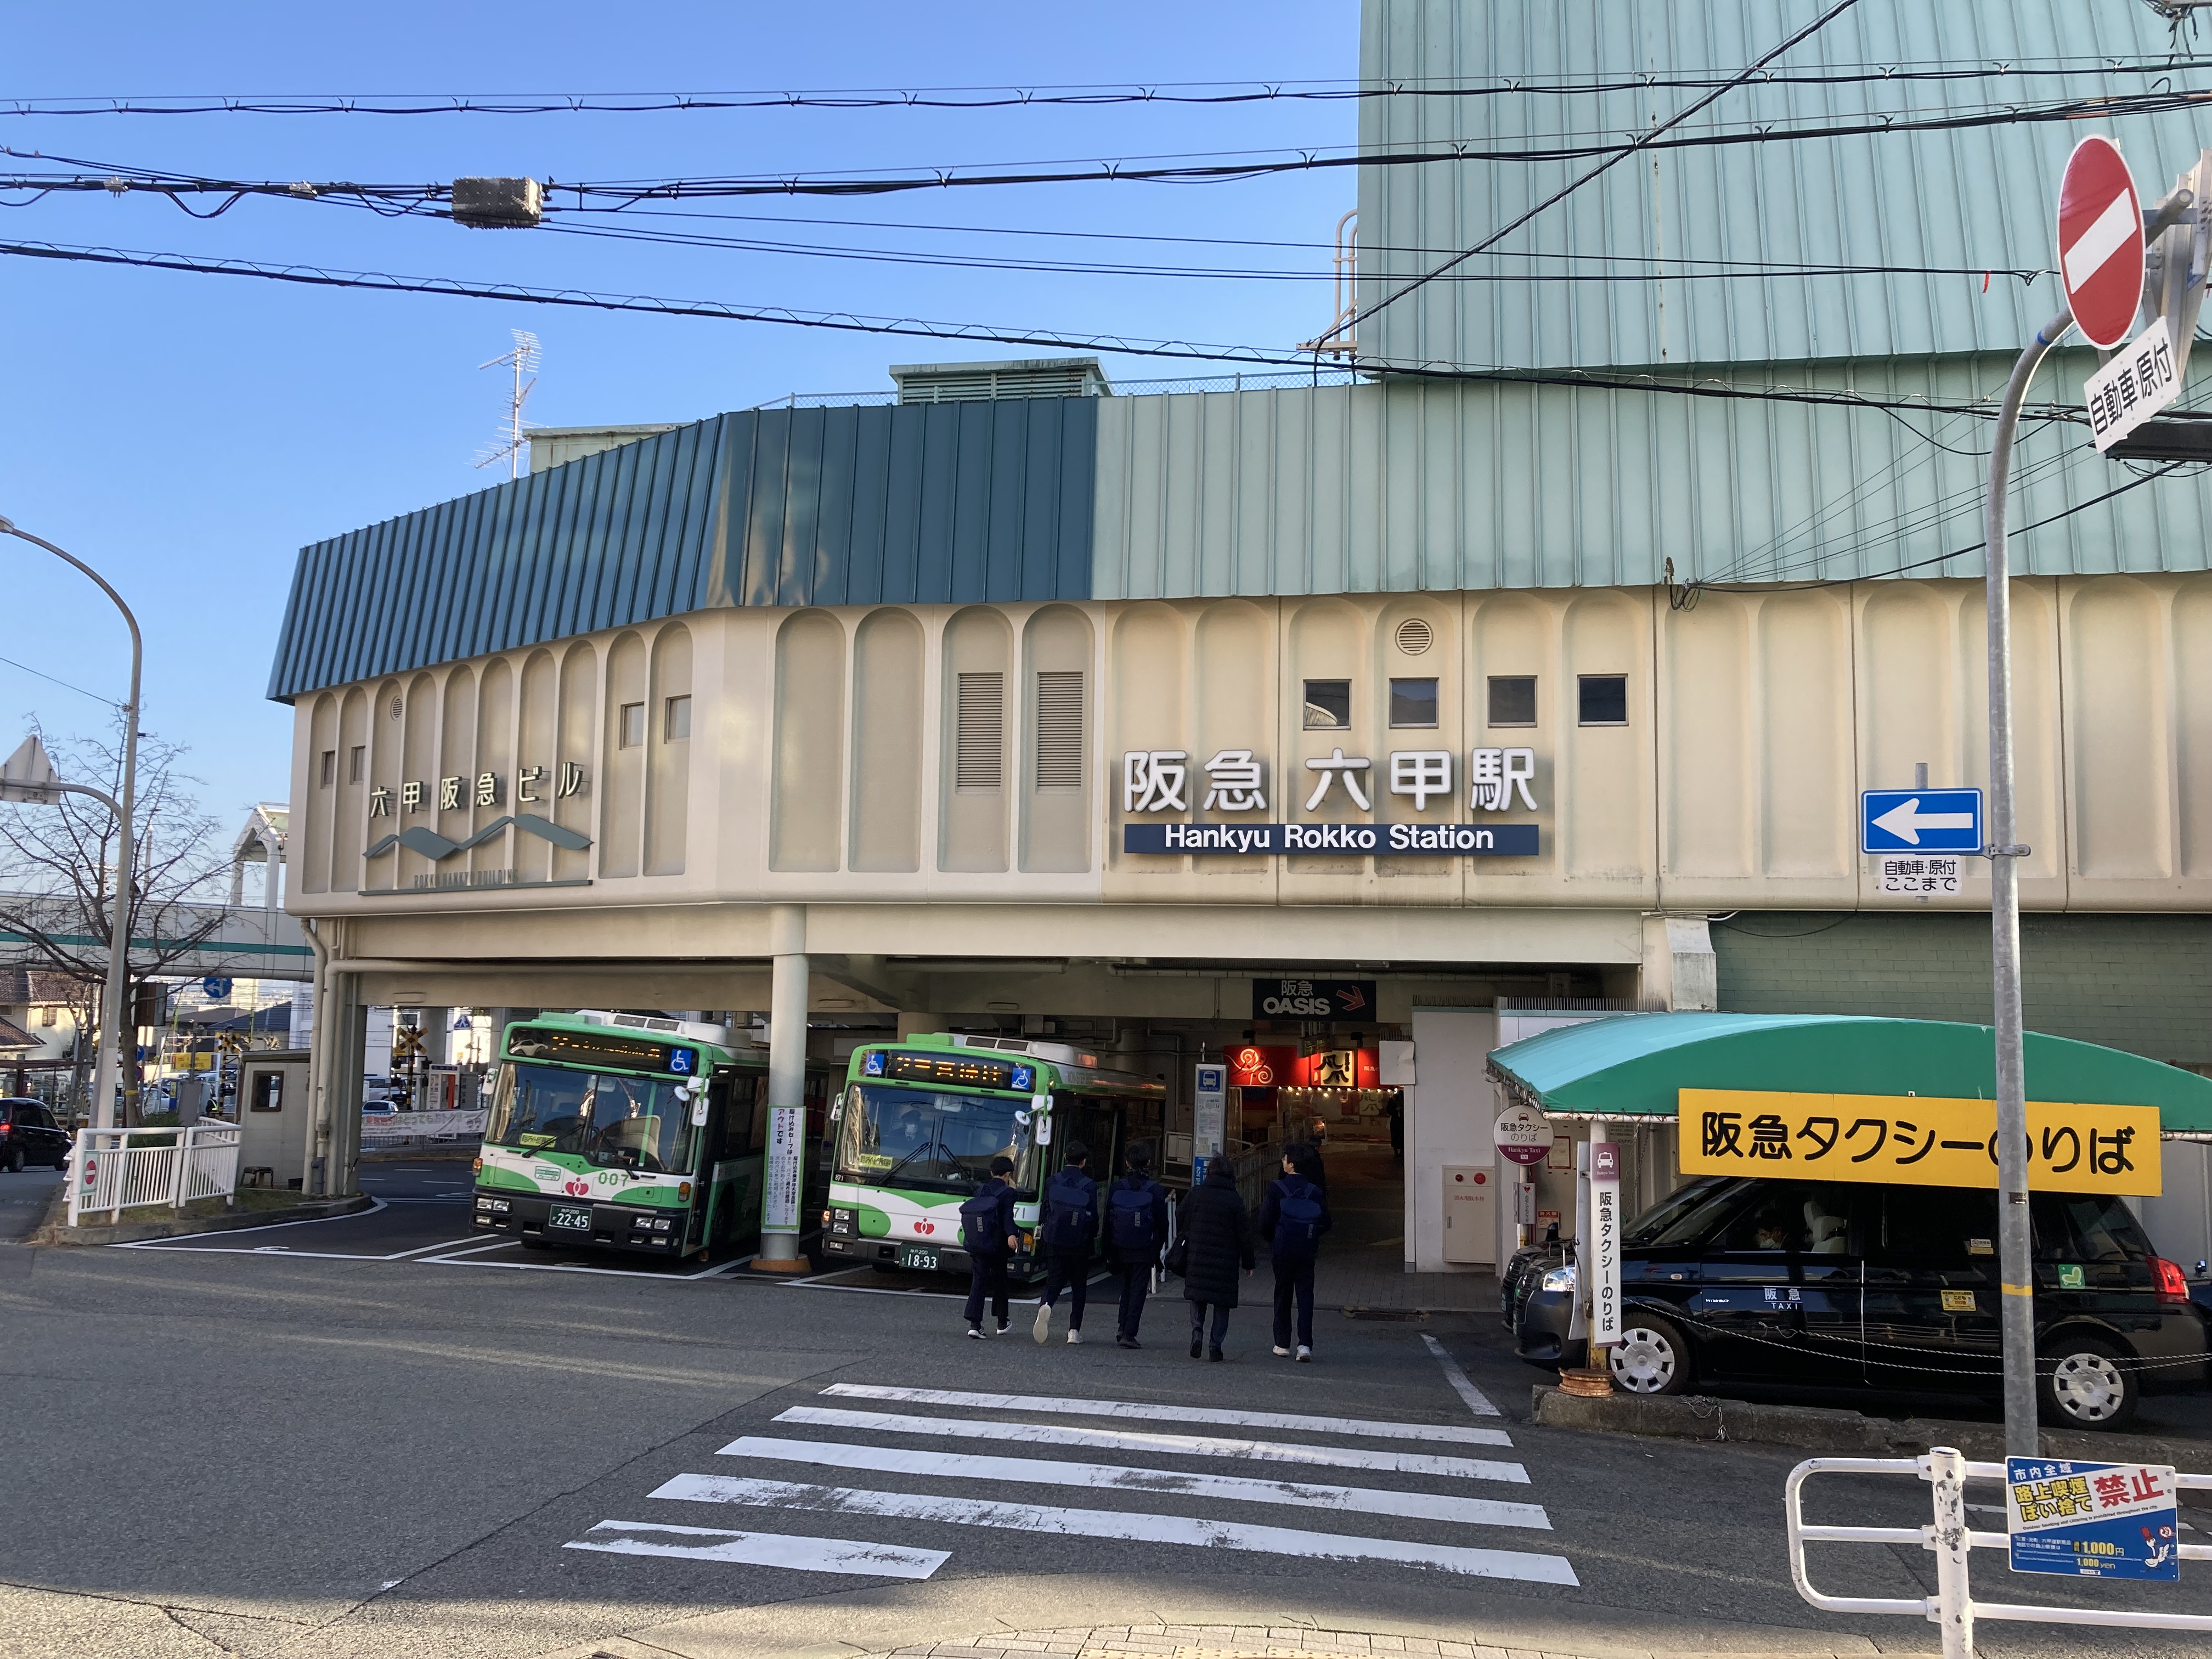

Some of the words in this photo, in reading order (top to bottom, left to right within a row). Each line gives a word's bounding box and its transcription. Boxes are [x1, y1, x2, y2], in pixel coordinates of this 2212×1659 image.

[2091, 337, 2172, 436] 自動車・原付
[1124, 747, 1537, 812] 阪急六甲駅
[370, 762, 583, 817] 六甲阪急ビル
[1165, 825, 1270, 853] Hankyu
[1284, 824, 1376, 849] Rokko
[1389, 825, 1494, 849] Station
[1884, 860, 1957, 875] 自動車・原付
[1886, 877, 1957, 891] ここまで
[1281, 980, 1313, 996] 阪急
[1263, 997, 1330, 1015] OASIS
[776, 1109, 785, 1144] アウトです
[1500, 1122, 1548, 1132] 阪急タクシー
[1510, 1133, 1537, 1142] のりば
[599, 1172, 629, 1187] 007
[1013, 1207, 1025, 1219] 71
[907, 1254, 937, 1268] 18-93
[1599, 1191, 1615, 1331] 阪急タクシーのりば
[1764, 1288, 1801, 1301] 阪急
[2013, 1462, 2073, 1481] 市内全域
[2013, 1476, 2090, 1504] 路上喫煙
[2094, 1468, 2164, 1508] 禁止
[2020, 1495, 2094, 1522] ぽい捨て
[2077, 1558, 2099, 1567] 1,000
